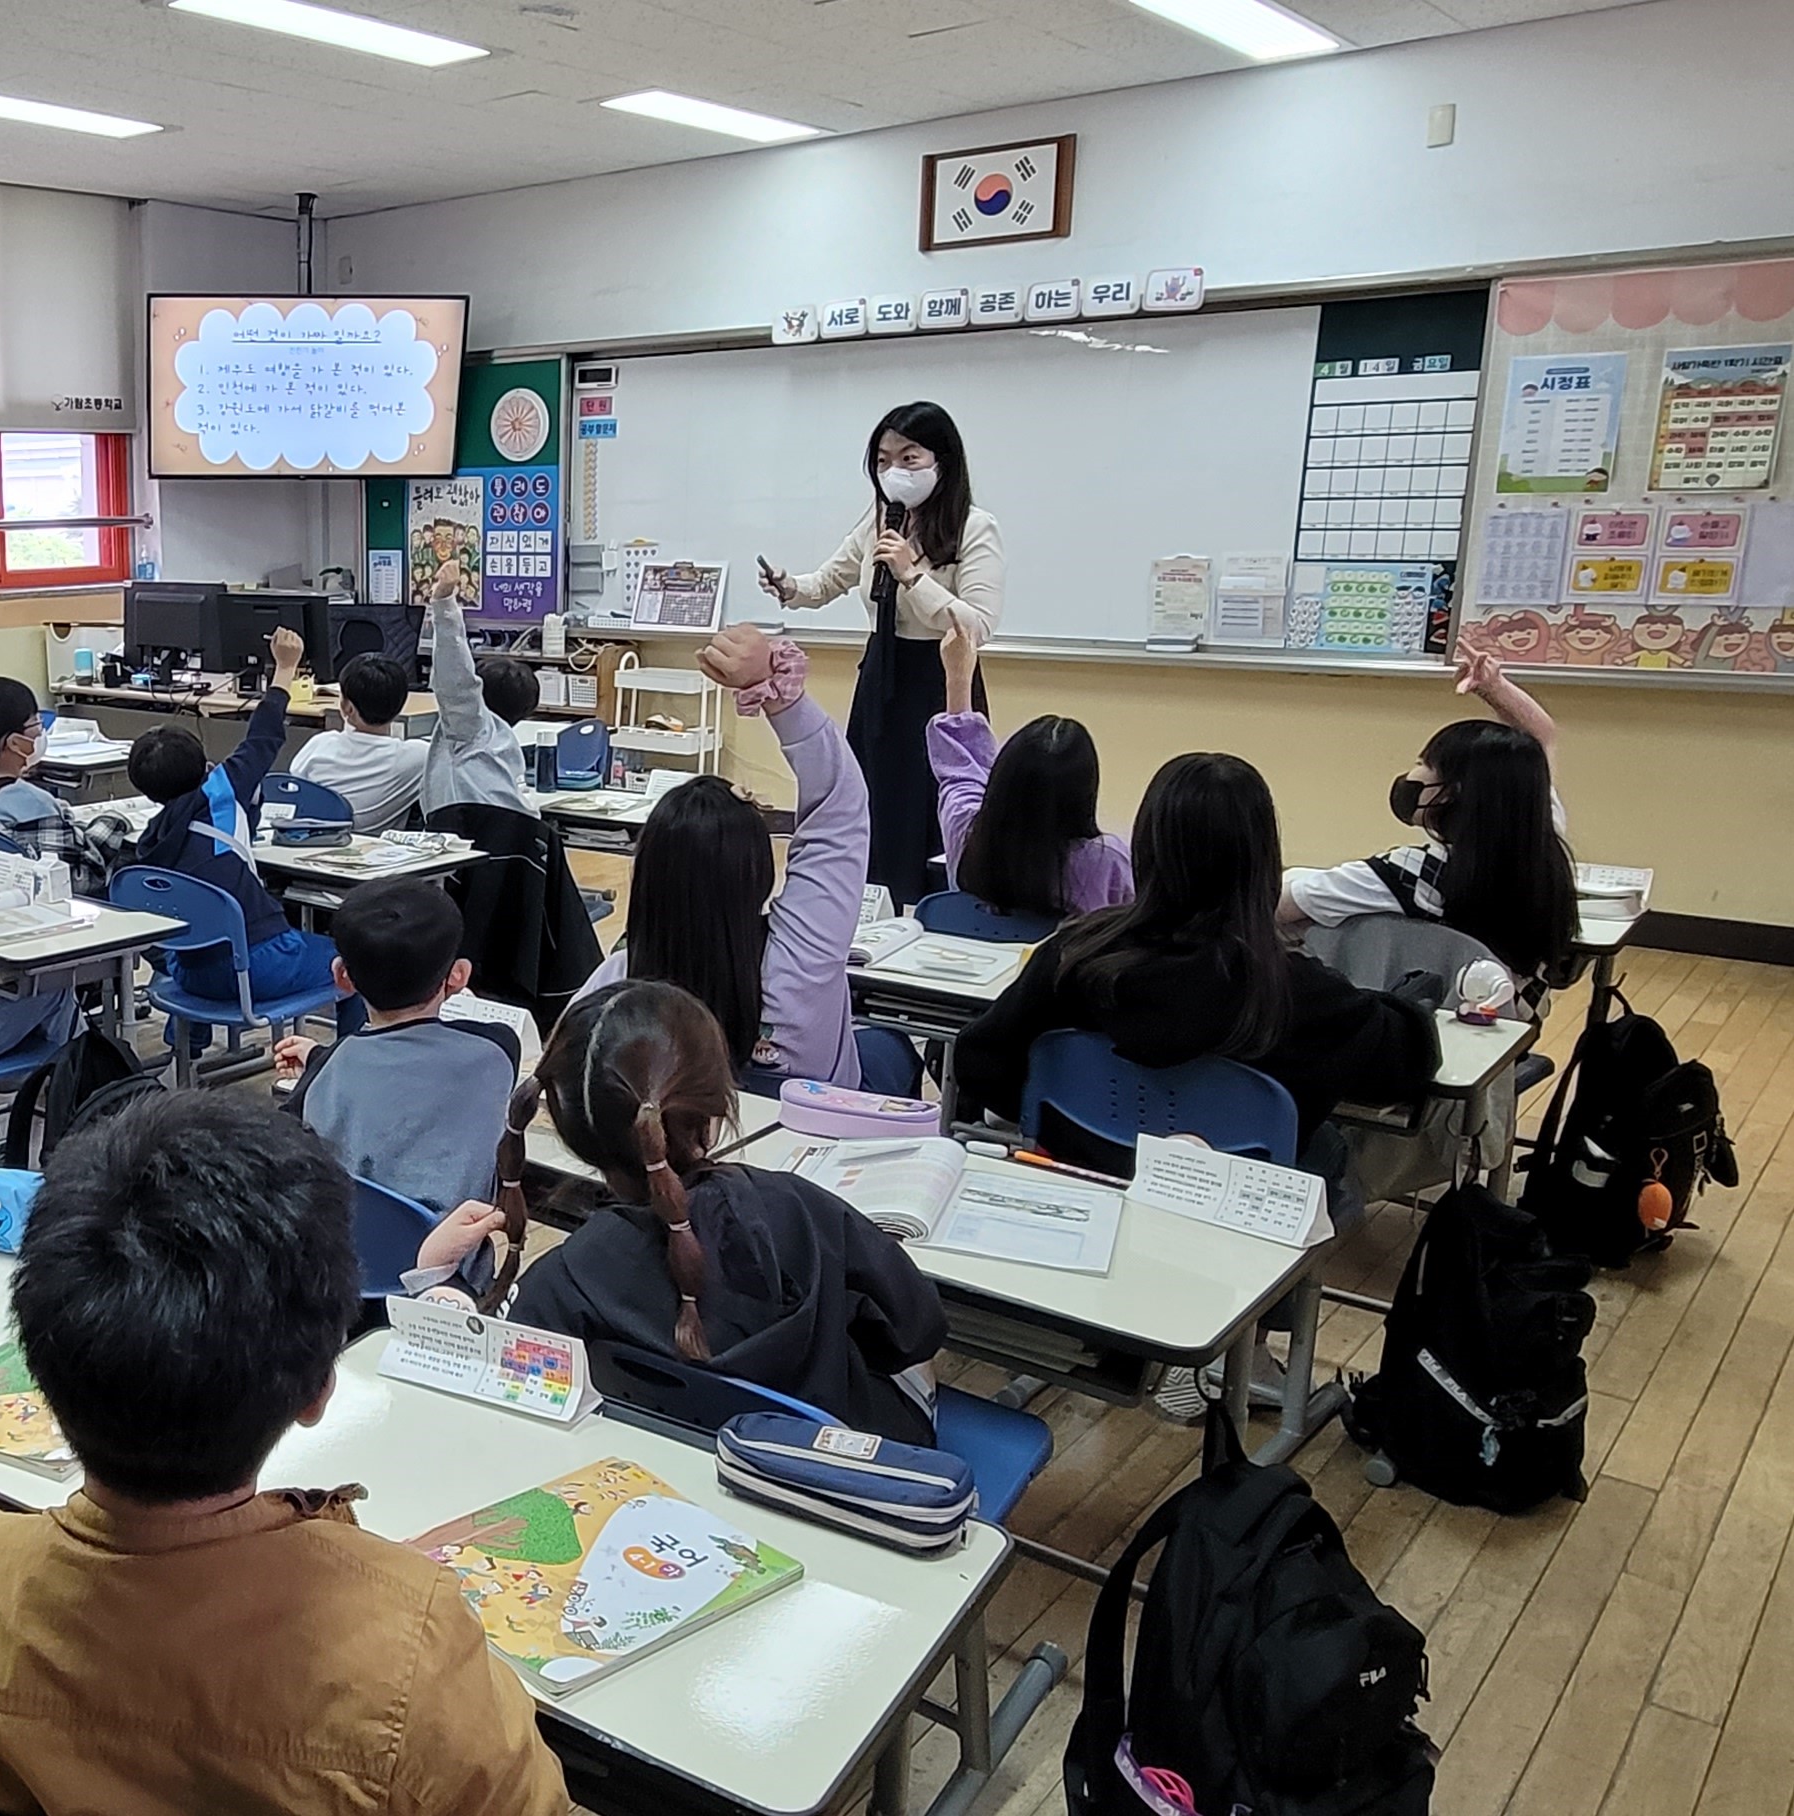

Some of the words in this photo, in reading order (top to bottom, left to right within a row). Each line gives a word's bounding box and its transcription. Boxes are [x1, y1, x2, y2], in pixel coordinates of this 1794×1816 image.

[826, 307, 860, 327] 서로
[875, 302, 910, 321] 도와
[927, 297, 961, 317] 함께
[979, 292, 1016, 313] 공존
[1034, 289, 1072, 309] 하는
[1092, 282, 1131, 303] 우리
[218, 363, 256, 375] 제주도
[265, 362, 302, 379] 여행을
[312, 365, 324, 374] 가
[331, 362, 342, 376] 본
[351, 363, 375, 376] 적이
[384, 364, 413, 377] 있다.
[198, 383, 210, 394] 2.
[218, 380, 256, 395] 인천에
[266, 384, 278, 393] 가
[286, 381, 296, 395] 본
[305, 382, 328, 395] 적이
[337, 382, 367, 396] 있다.
[1540, 375, 1591, 390] 시정표
[64, 396, 123, 411] 가람초등학교
[197, 404, 210, 416] 3.
[219, 402, 269, 416] 강원도에
[278, 404, 302, 414] 가서
[310, 401, 360, 419] 닭갈비를
[197, 421, 221, 435] 적이
[230, 421, 260, 435] 있다.
[493, 582, 512, 593] 너의
[514, 581, 543, 597] 생각을
[1444, 1376, 1468, 1402] FILA
[650, 1533, 709, 1568] 국어
[629, 1553, 656, 1570] 4-1
[663, 1565, 681, 1577] 가
[1359, 1666, 1387, 1687] FILA
